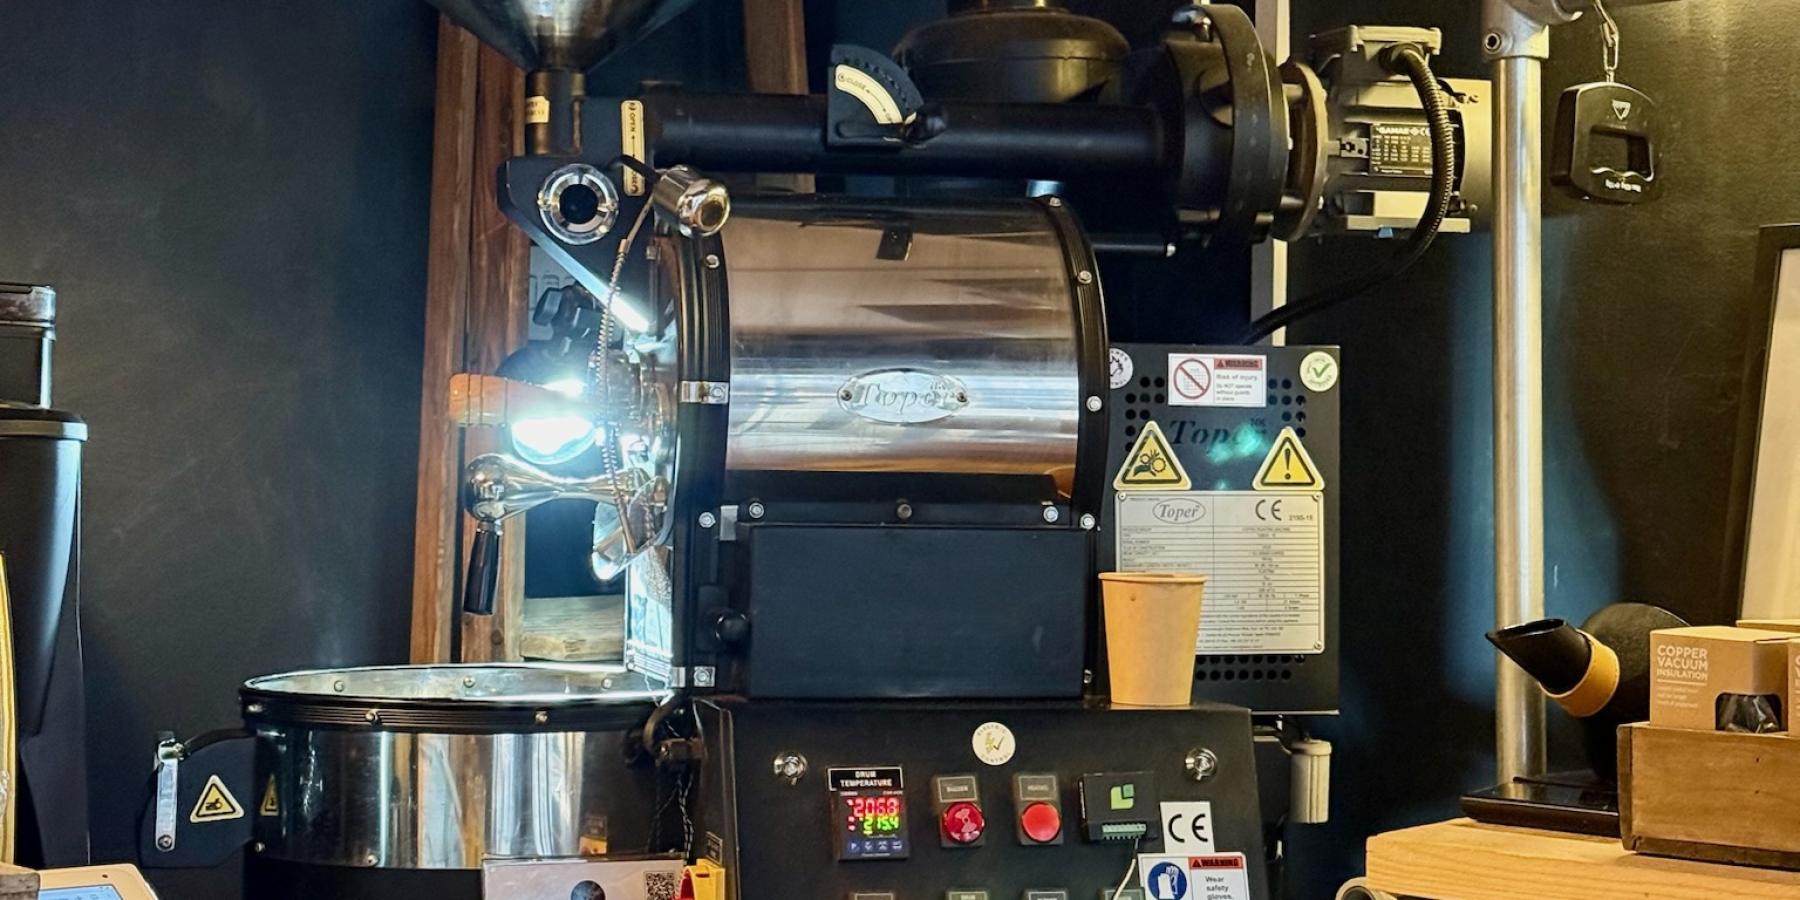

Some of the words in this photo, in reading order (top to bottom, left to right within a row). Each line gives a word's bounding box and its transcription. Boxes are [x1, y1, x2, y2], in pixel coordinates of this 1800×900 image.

[1159, 504, 1199, 521] Toper
[1255, 499, 1282, 521] CE
[1657, 645, 1708, 660] COPPER
[1657, 656, 1708, 671] VACUUM
[1657, 668, 1708, 681] INSULATION
[855, 770, 877, 778] DRUM
[840, 778, 893, 788] TEMPERATURE
[1168, 813, 1209, 844] CE
[1200, 858, 1239, 867] WARNING
[1206, 884, 1229, 892] safety
